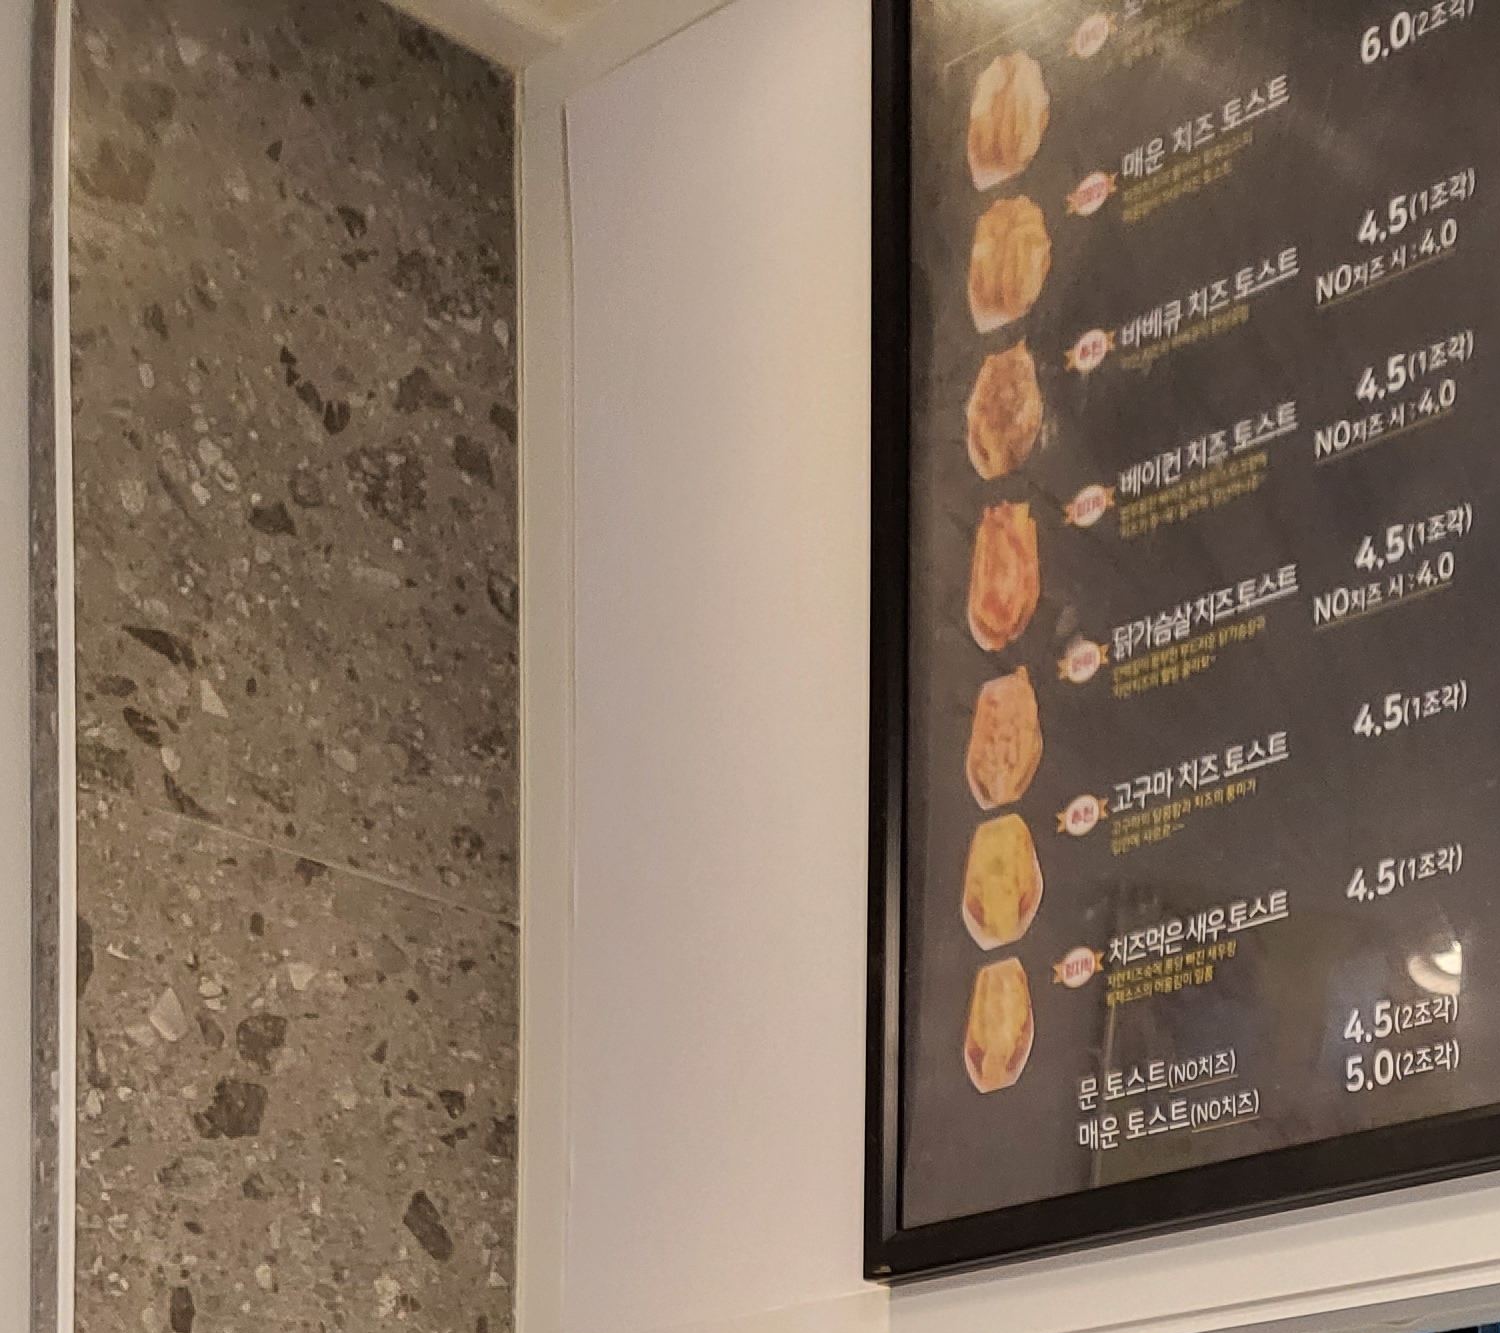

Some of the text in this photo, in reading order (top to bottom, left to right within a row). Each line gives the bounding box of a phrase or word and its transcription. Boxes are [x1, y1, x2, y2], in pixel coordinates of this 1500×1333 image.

[1112, 731, 1289, 813] 고구마 치즈 토스트
[1186, 909, 1226, 943] 새우
[1227, 890, 1288, 933] 토스트
[1078, 1077, 1098, 1111] 문
[1079, 1117, 1120, 1150] 매운
